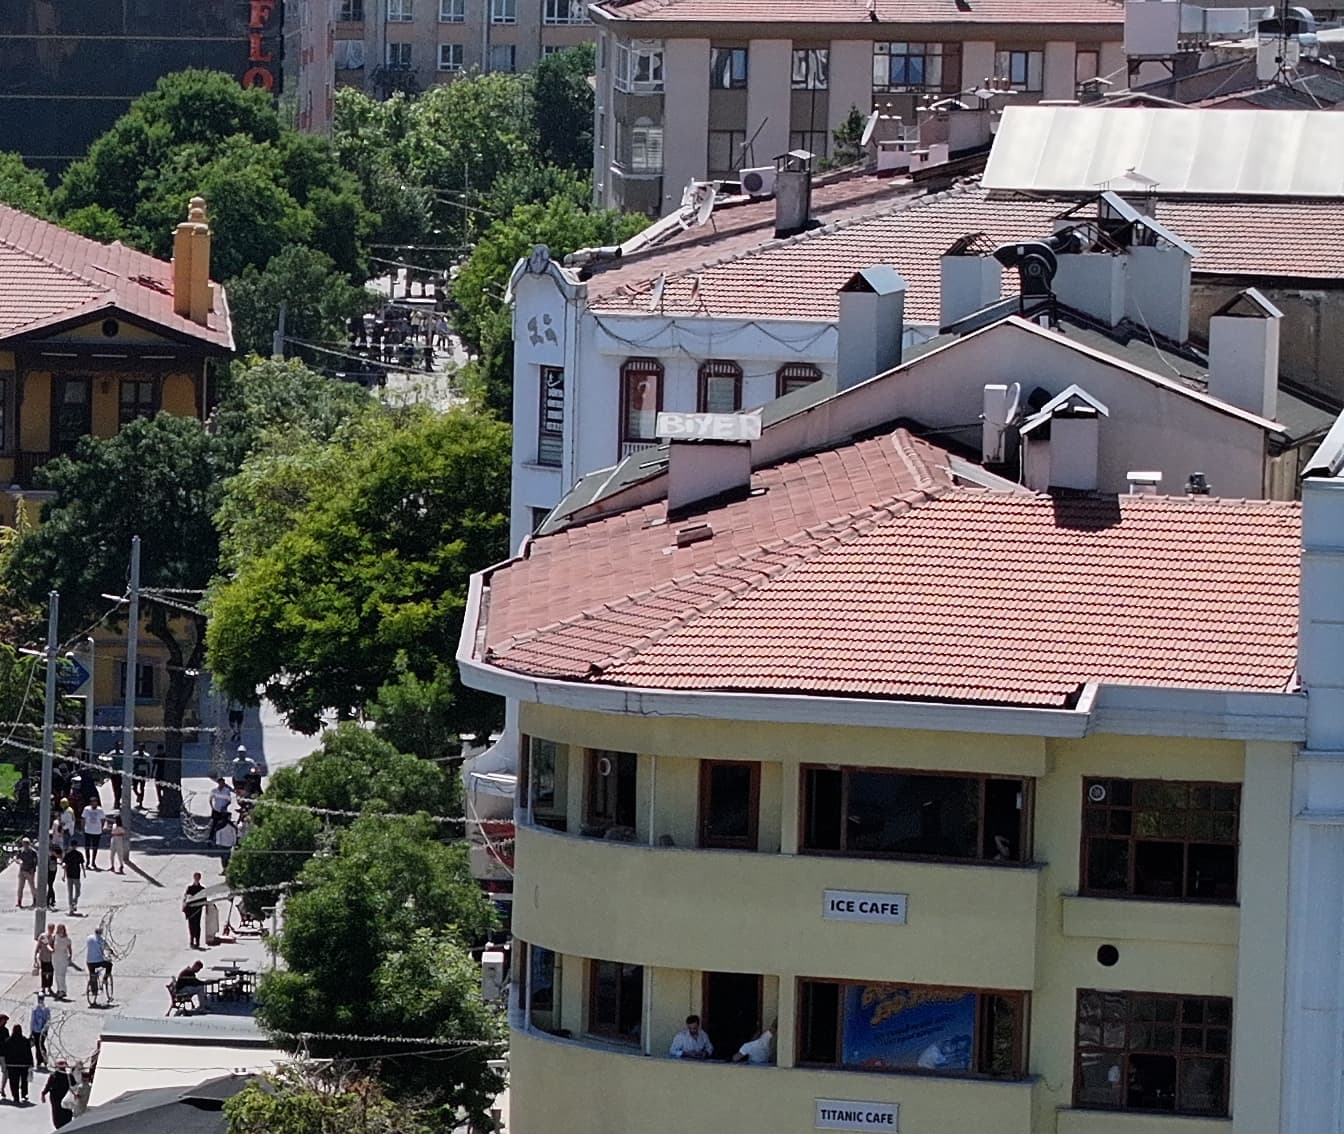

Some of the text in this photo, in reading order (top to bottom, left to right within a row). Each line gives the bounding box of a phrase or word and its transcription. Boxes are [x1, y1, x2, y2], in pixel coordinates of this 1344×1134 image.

[830, 900, 899, 915] ICE CAFE
[821, 1109, 894, 1124] TITANIC CAFE
